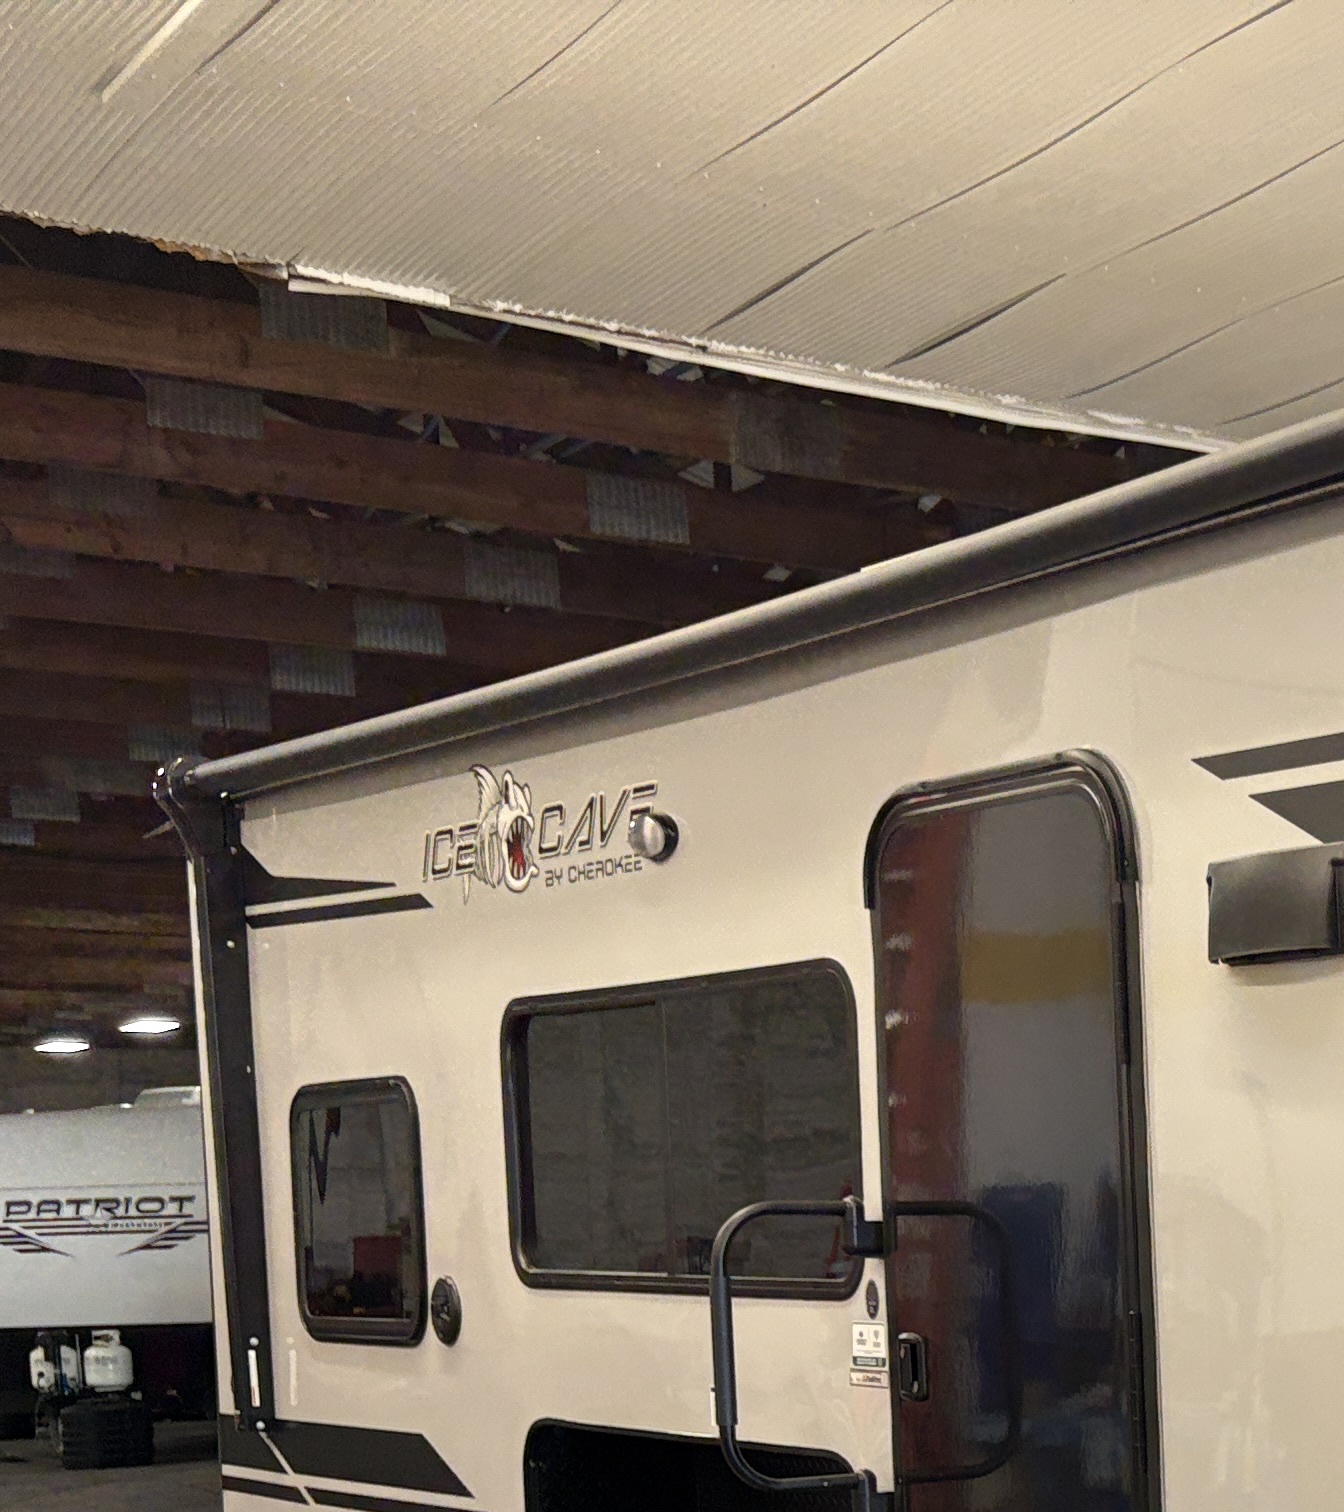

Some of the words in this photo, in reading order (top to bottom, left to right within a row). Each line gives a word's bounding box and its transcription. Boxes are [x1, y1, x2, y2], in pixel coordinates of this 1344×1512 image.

[422, 820, 480, 882] ICE
[545, 867, 563, 887] BY
[567, 854, 643, 883] CHEROKEE
[5, 1194, 197, 1218] PATRIOT
